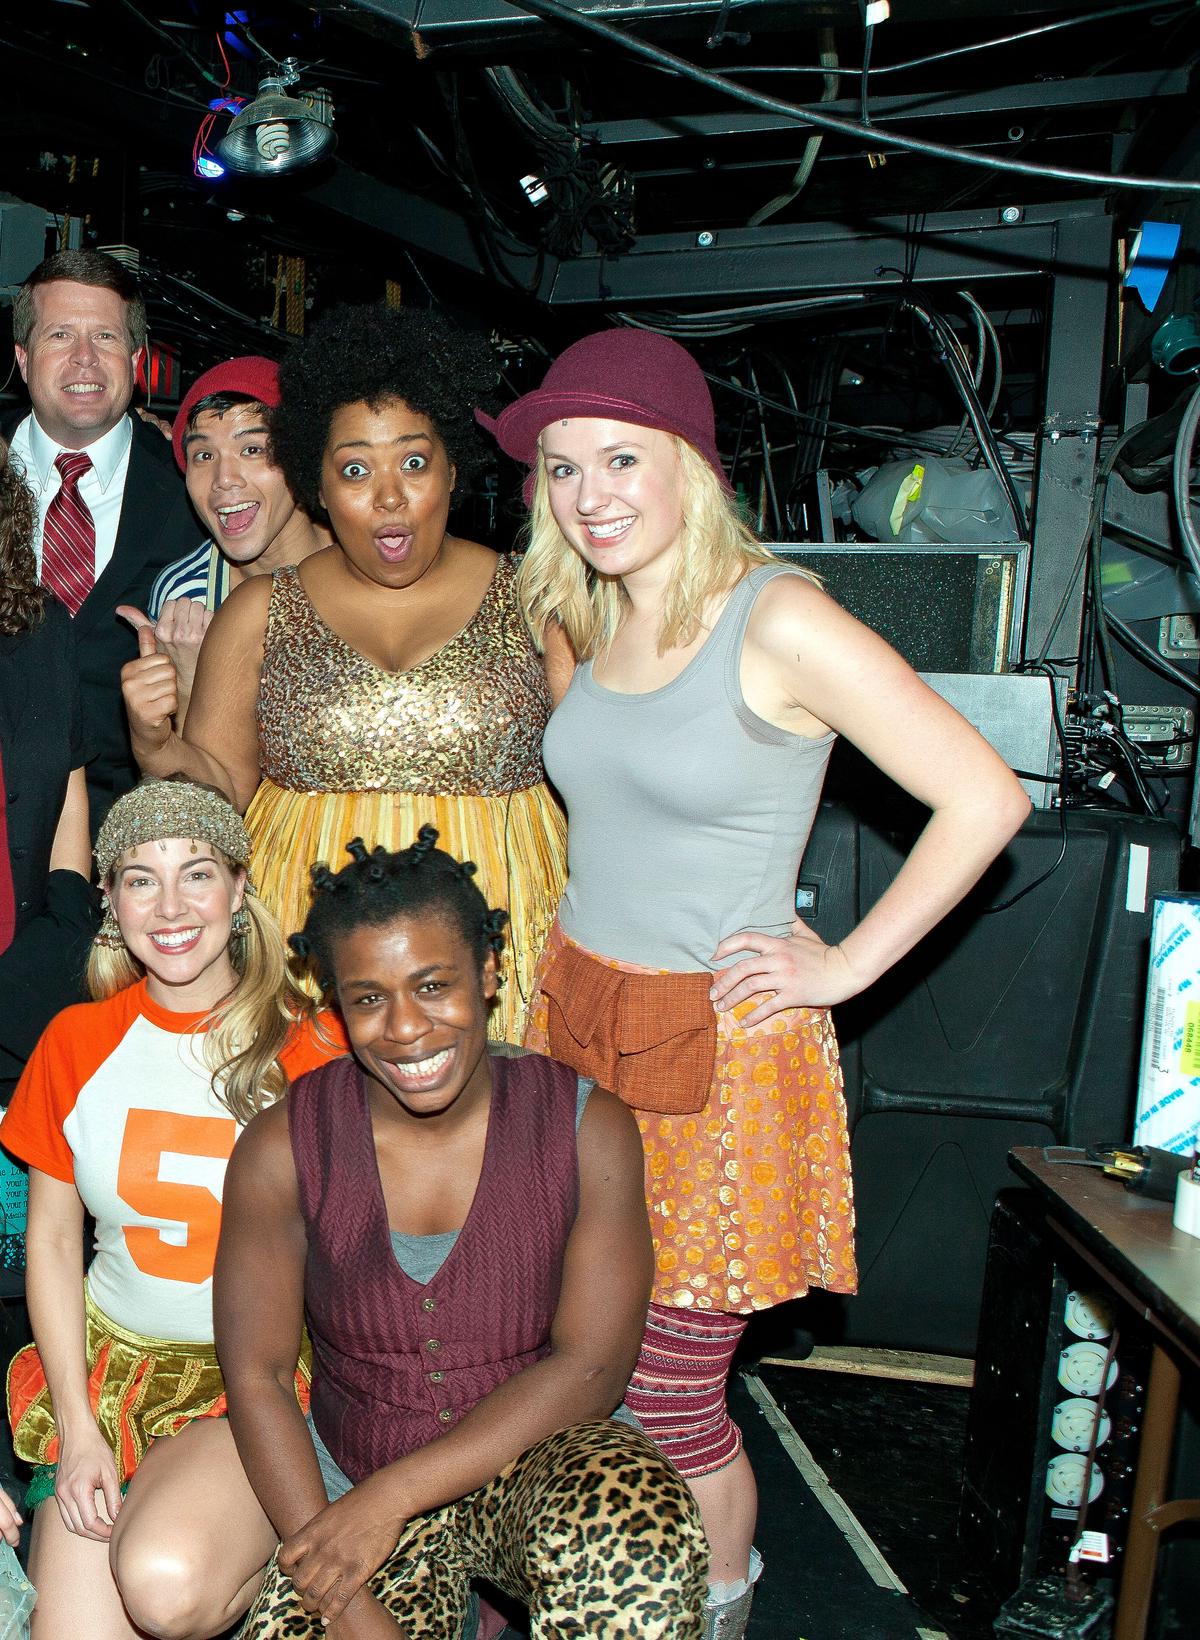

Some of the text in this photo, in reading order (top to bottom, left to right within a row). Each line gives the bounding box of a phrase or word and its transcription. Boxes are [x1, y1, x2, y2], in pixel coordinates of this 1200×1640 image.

[137, 344, 176, 397] XIT
[1154, 929, 1192, 968] HAYWARD
[1158, 1088, 1185, 1108] MADE
[6, 1180, 22, 1189] your
[6, 1191, 21, 1200] your
[117, 1108, 237, 1285] 5
[6, 1201, 22, 1211] your
